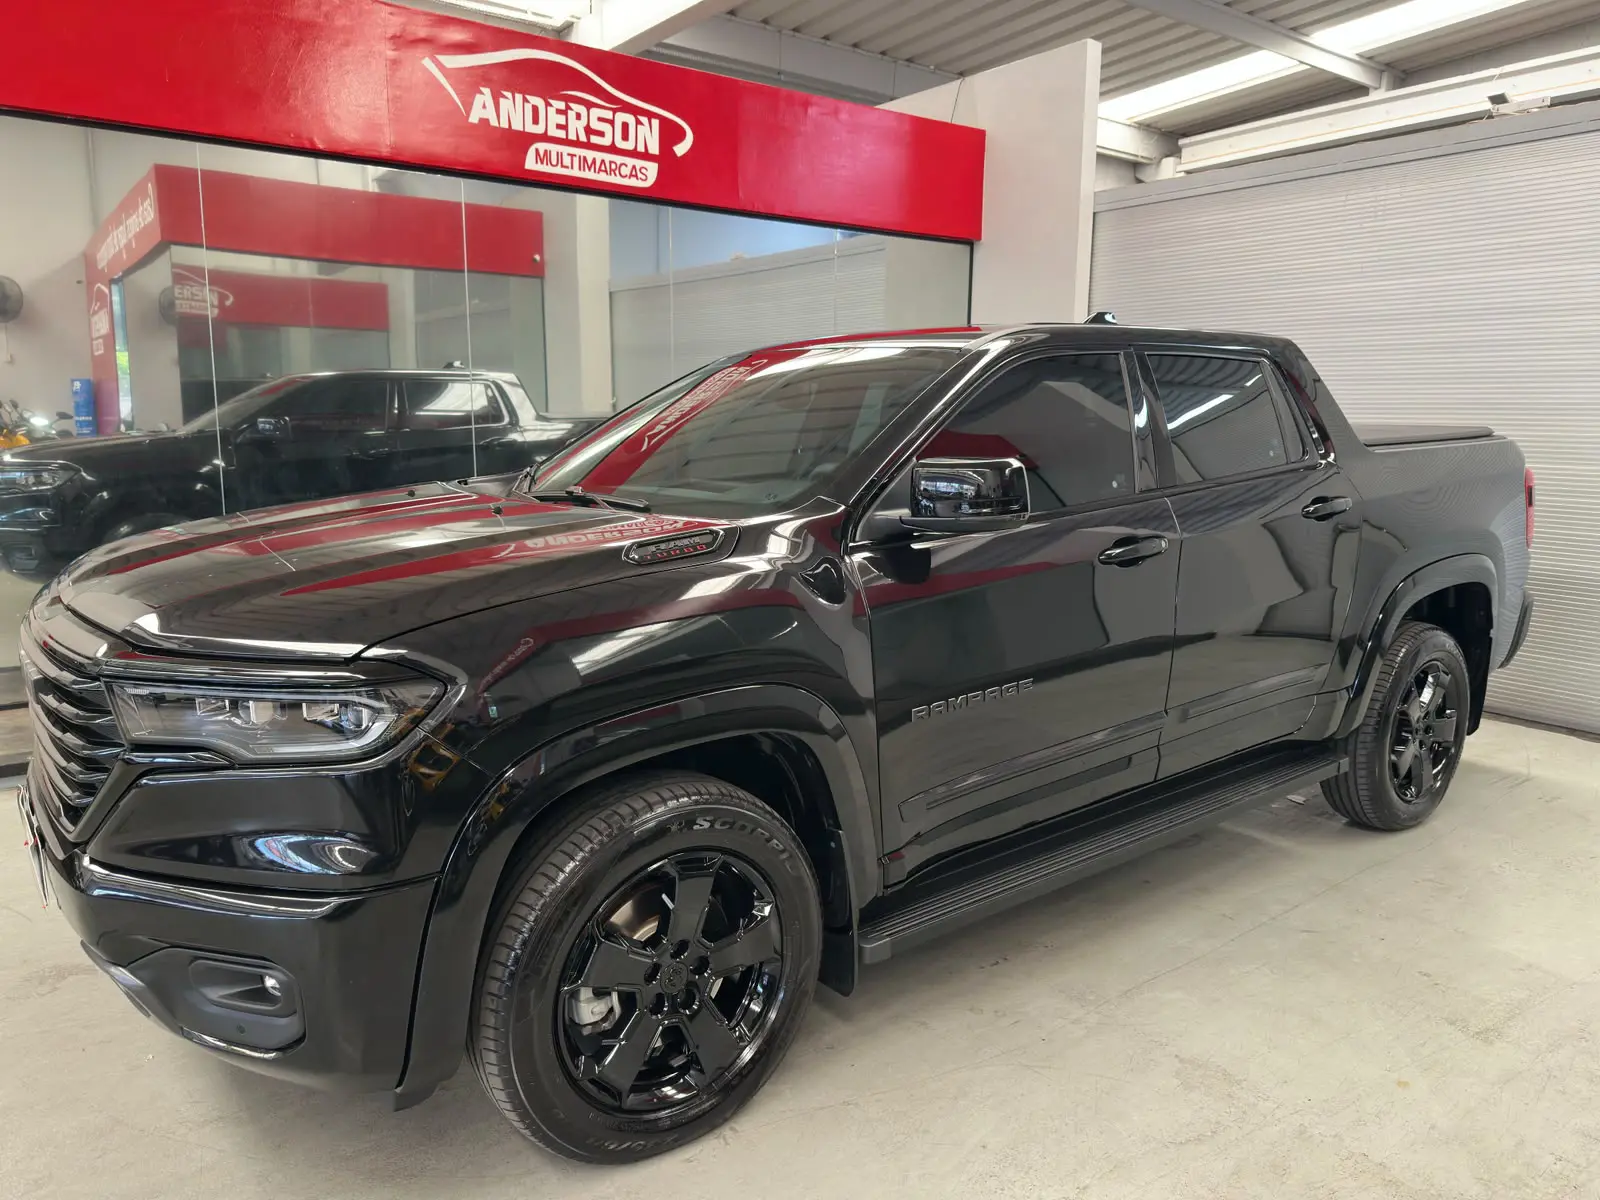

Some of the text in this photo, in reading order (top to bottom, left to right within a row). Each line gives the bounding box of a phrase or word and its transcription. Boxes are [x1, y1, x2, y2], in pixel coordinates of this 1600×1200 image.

[468, 86, 659, 155] ANDERSON
[534, 147, 648, 182] MULTIMARCAS
[911, 677, 1034, 722] RAMPAGE
